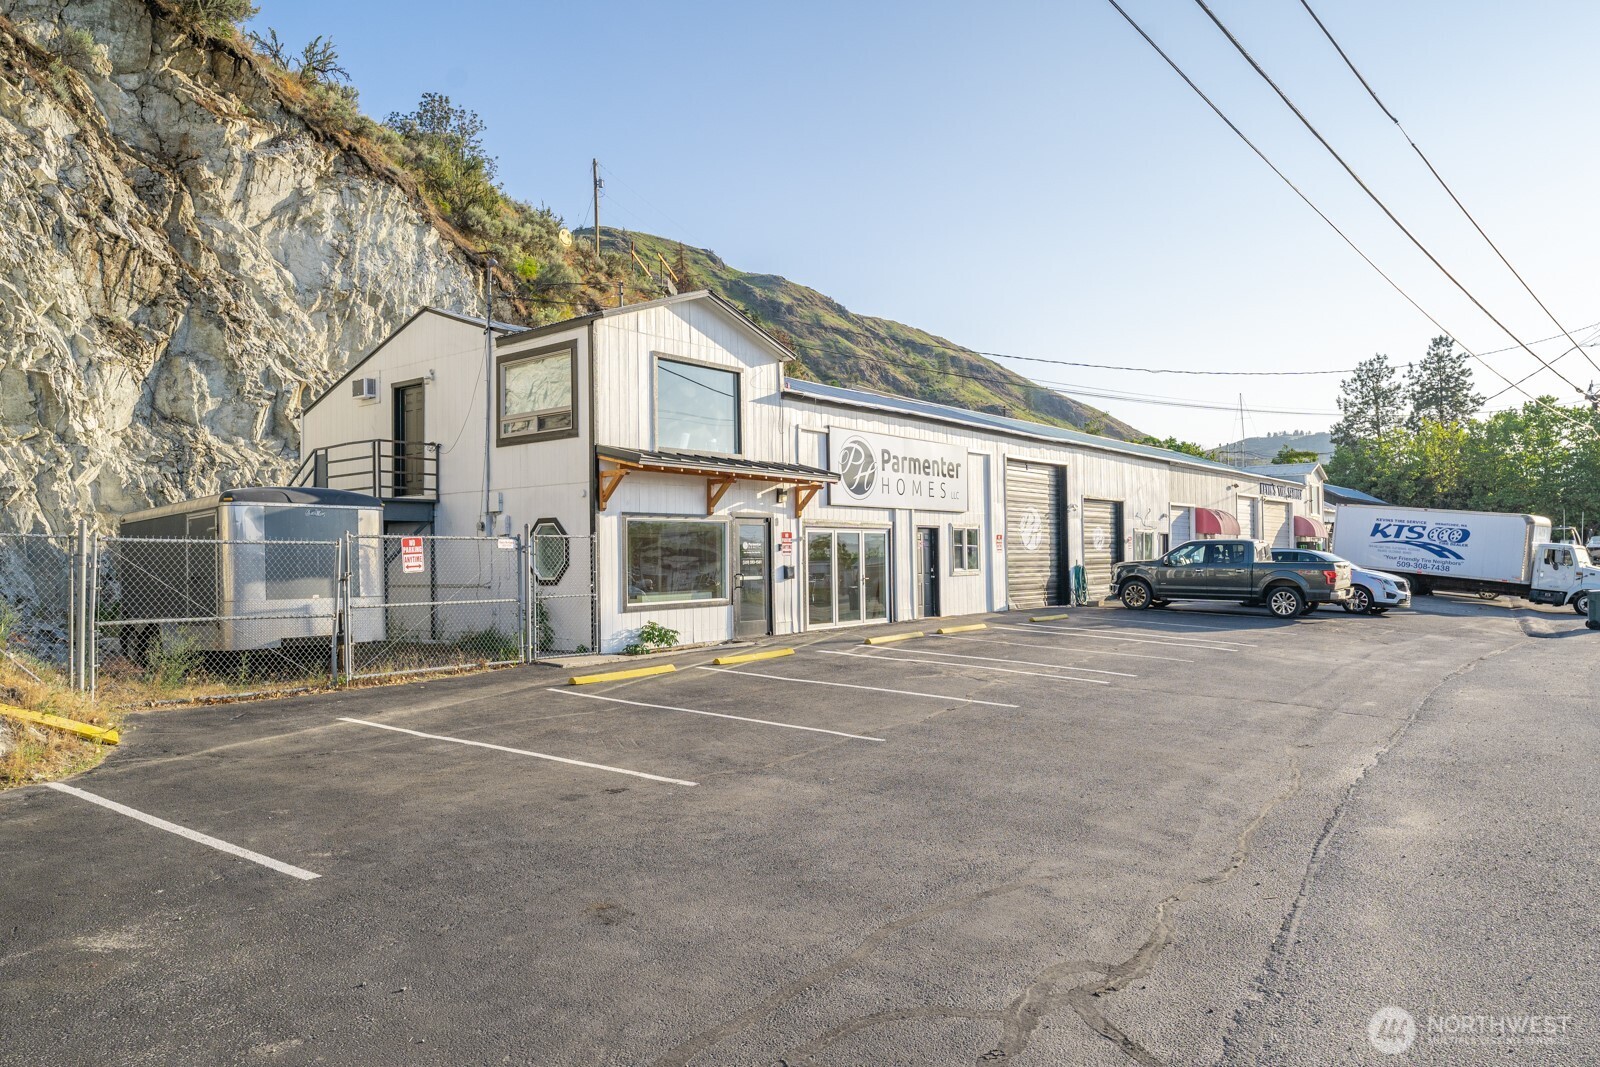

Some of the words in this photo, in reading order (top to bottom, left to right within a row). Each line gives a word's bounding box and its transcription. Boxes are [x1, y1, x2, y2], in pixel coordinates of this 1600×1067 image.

[881, 448, 962, 479] Parmenter
[881, 476, 947, 499] HOMES
[950, 490, 960, 500] LLC
[1370, 523, 1426, 539] KTS
[408, 539, 416, 547] NO
[404, 555, 423, 563] ANYTIME
[1398, 555, 1420, 563] Friendly
[1432, 558, 1464, 566] Neighbors"
[1396, 560, 1450, 571] 509-308-7438
